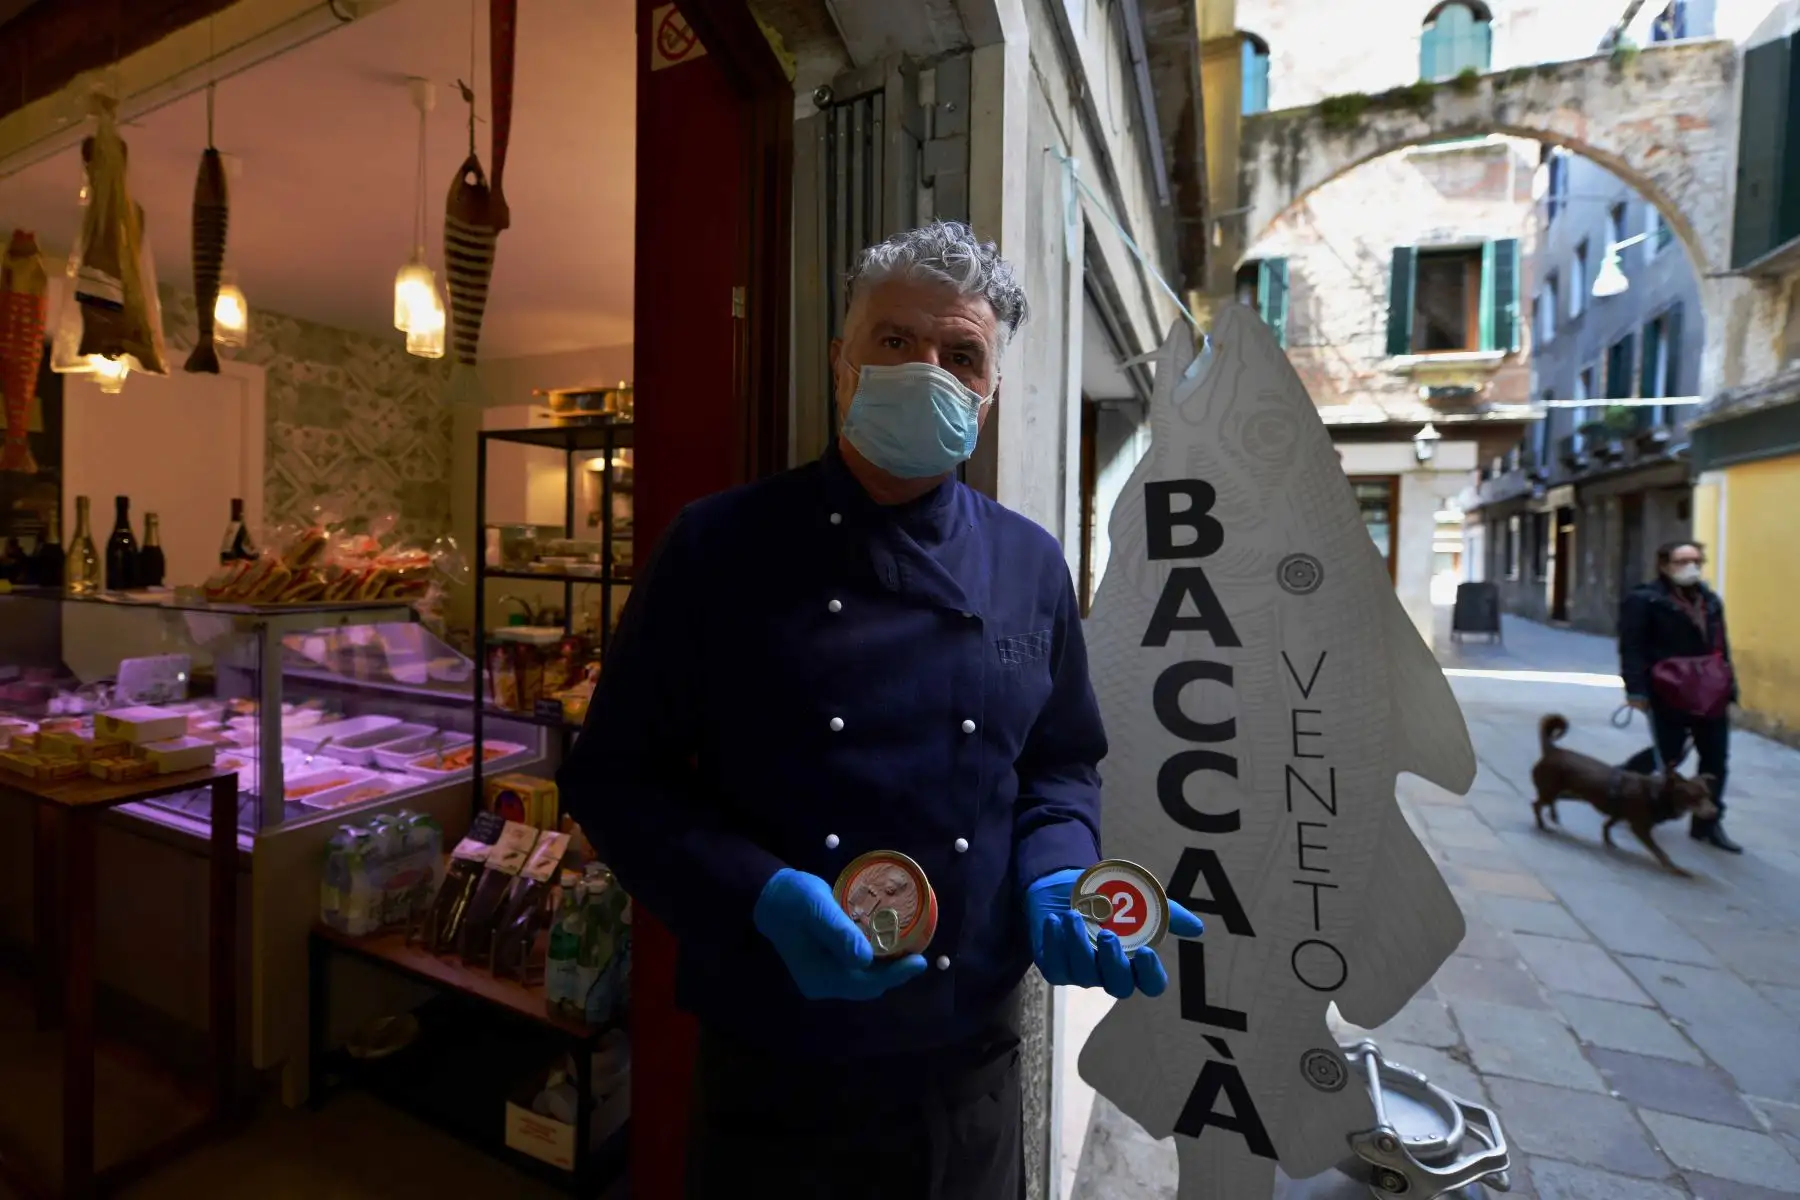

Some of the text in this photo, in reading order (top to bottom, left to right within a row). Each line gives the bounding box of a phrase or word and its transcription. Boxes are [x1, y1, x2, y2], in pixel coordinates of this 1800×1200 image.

[1112, 891, 1137, 924] 2
[1141, 479, 1278, 1160] BACCALÀ
[1282, 651, 1347, 991] VENETO
